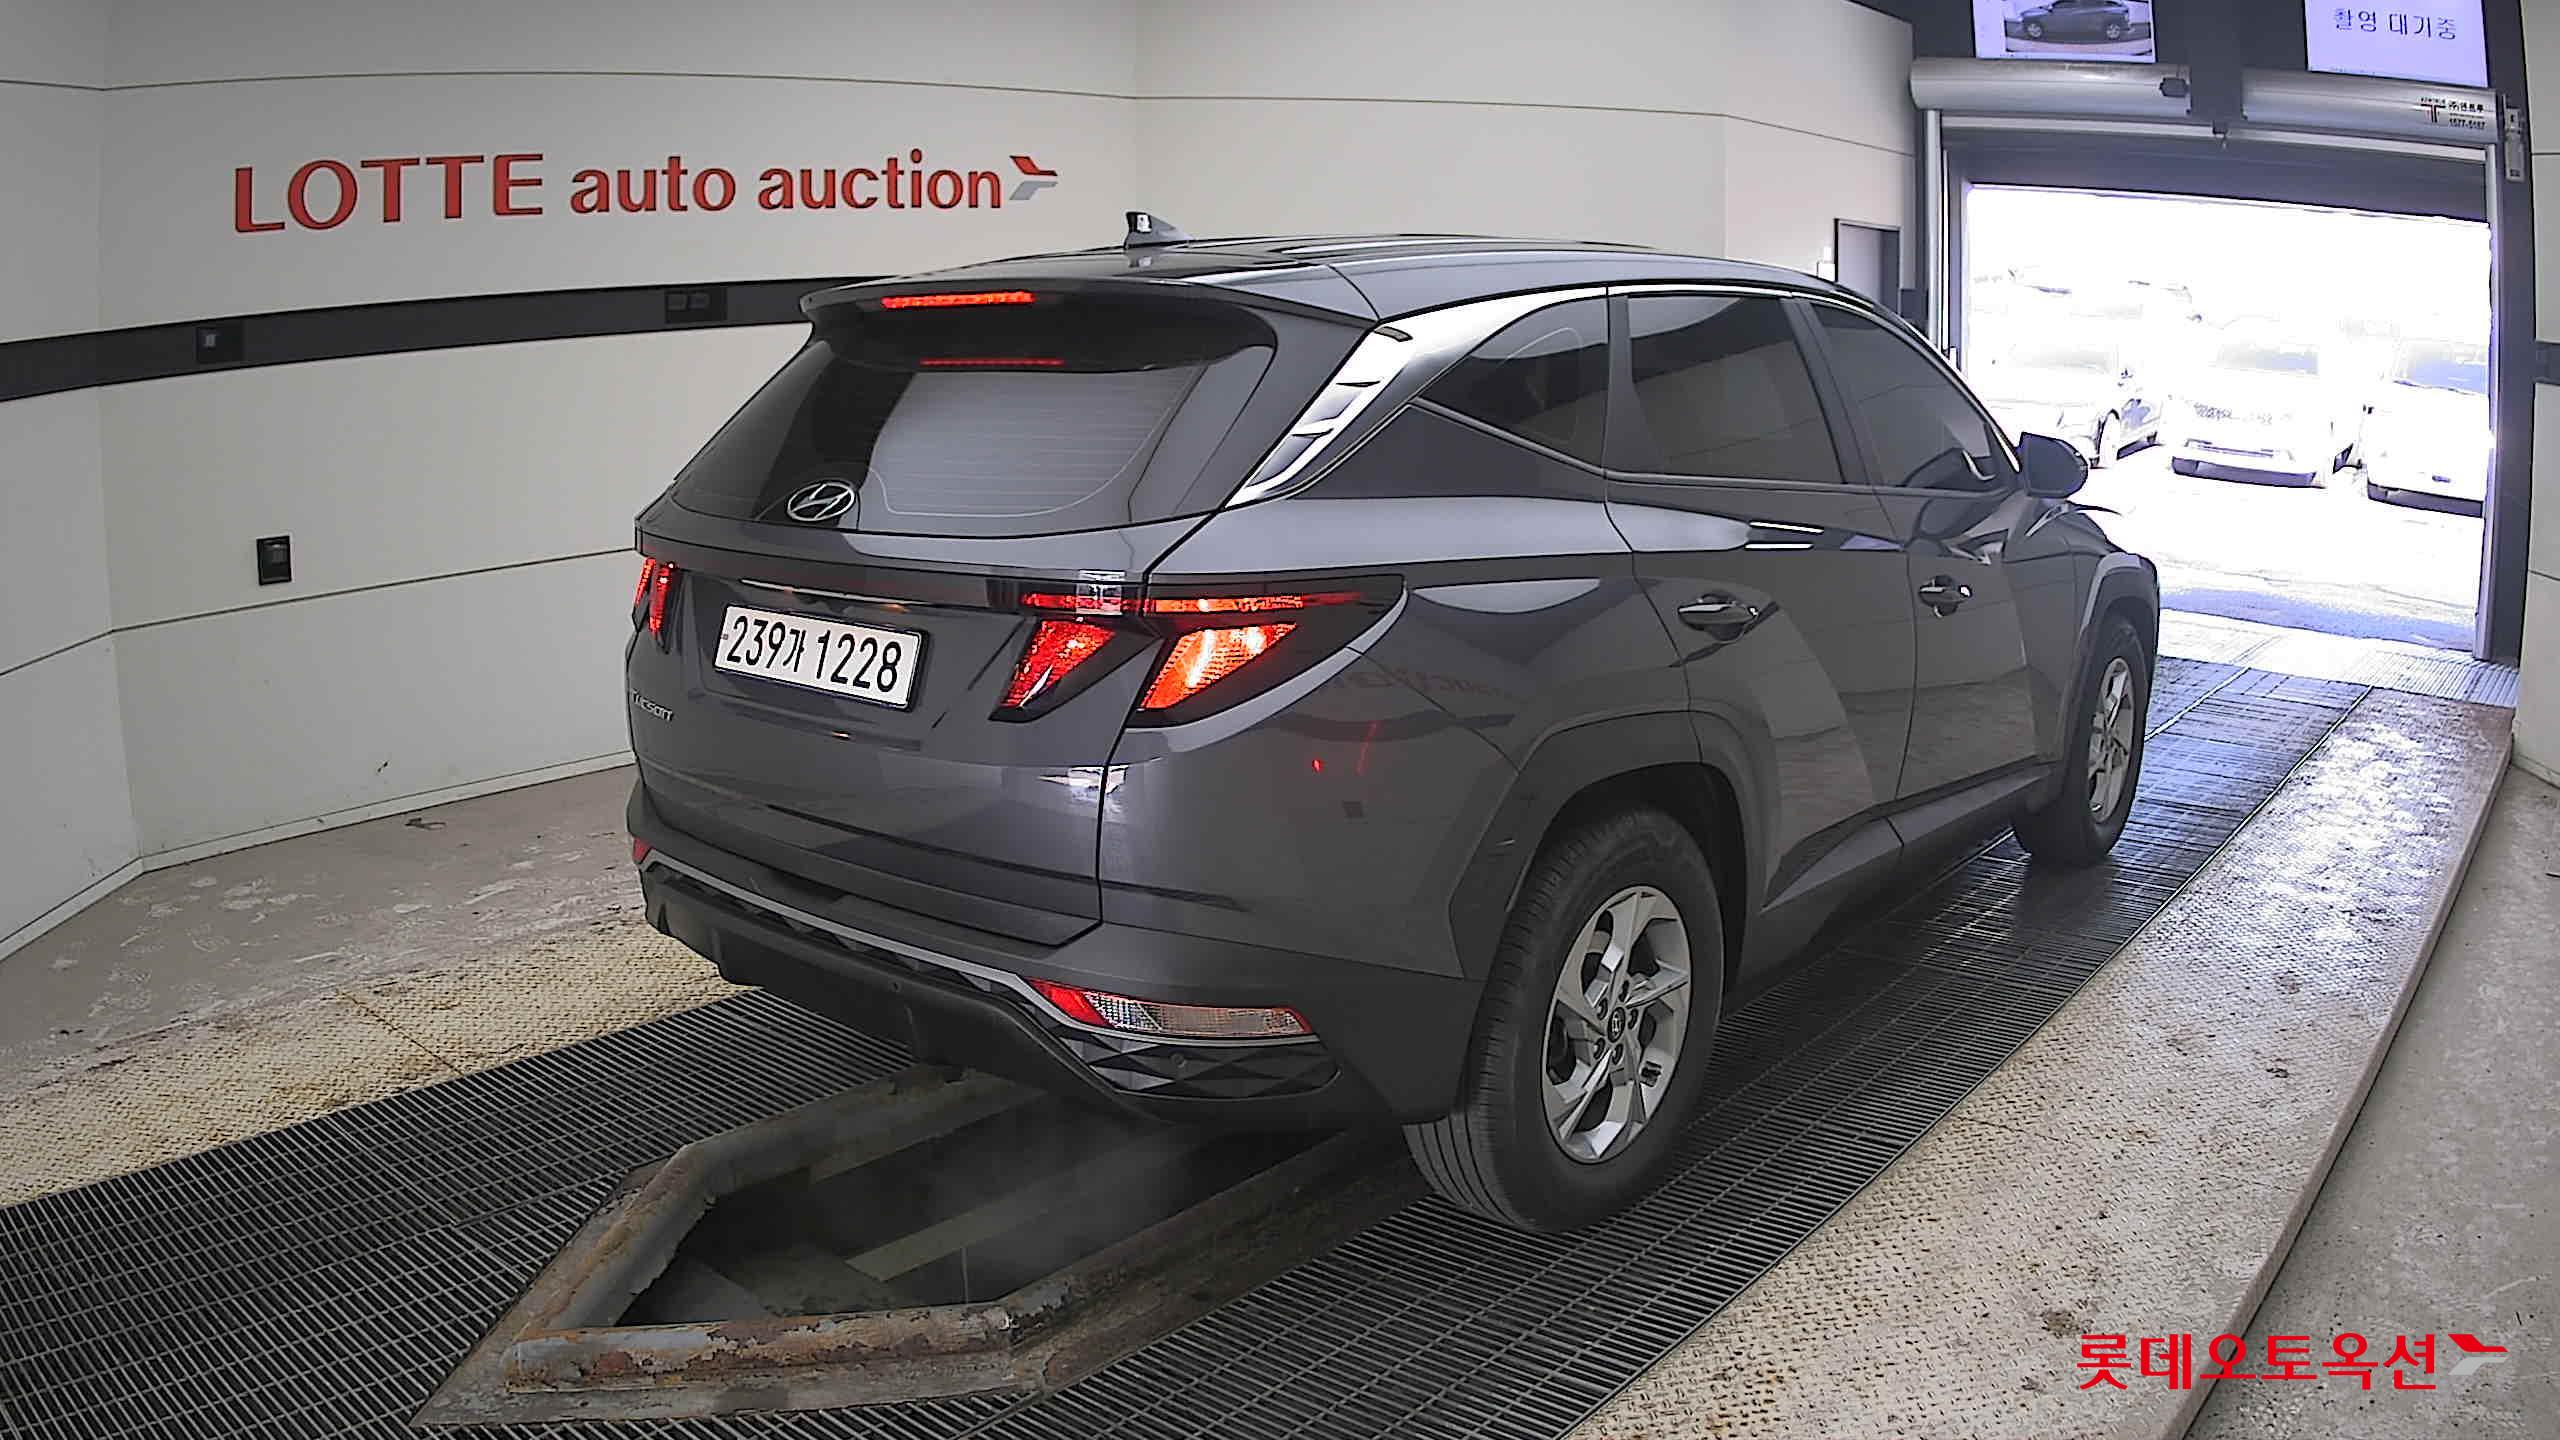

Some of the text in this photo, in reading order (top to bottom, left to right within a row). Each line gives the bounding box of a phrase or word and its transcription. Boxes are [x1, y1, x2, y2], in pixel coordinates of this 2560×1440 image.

[2389, 13, 2457, 40] 대기중
[233, 147, 1004, 233] LOTTE auto auction
[726, 615, 901, 693] 239가 1228
